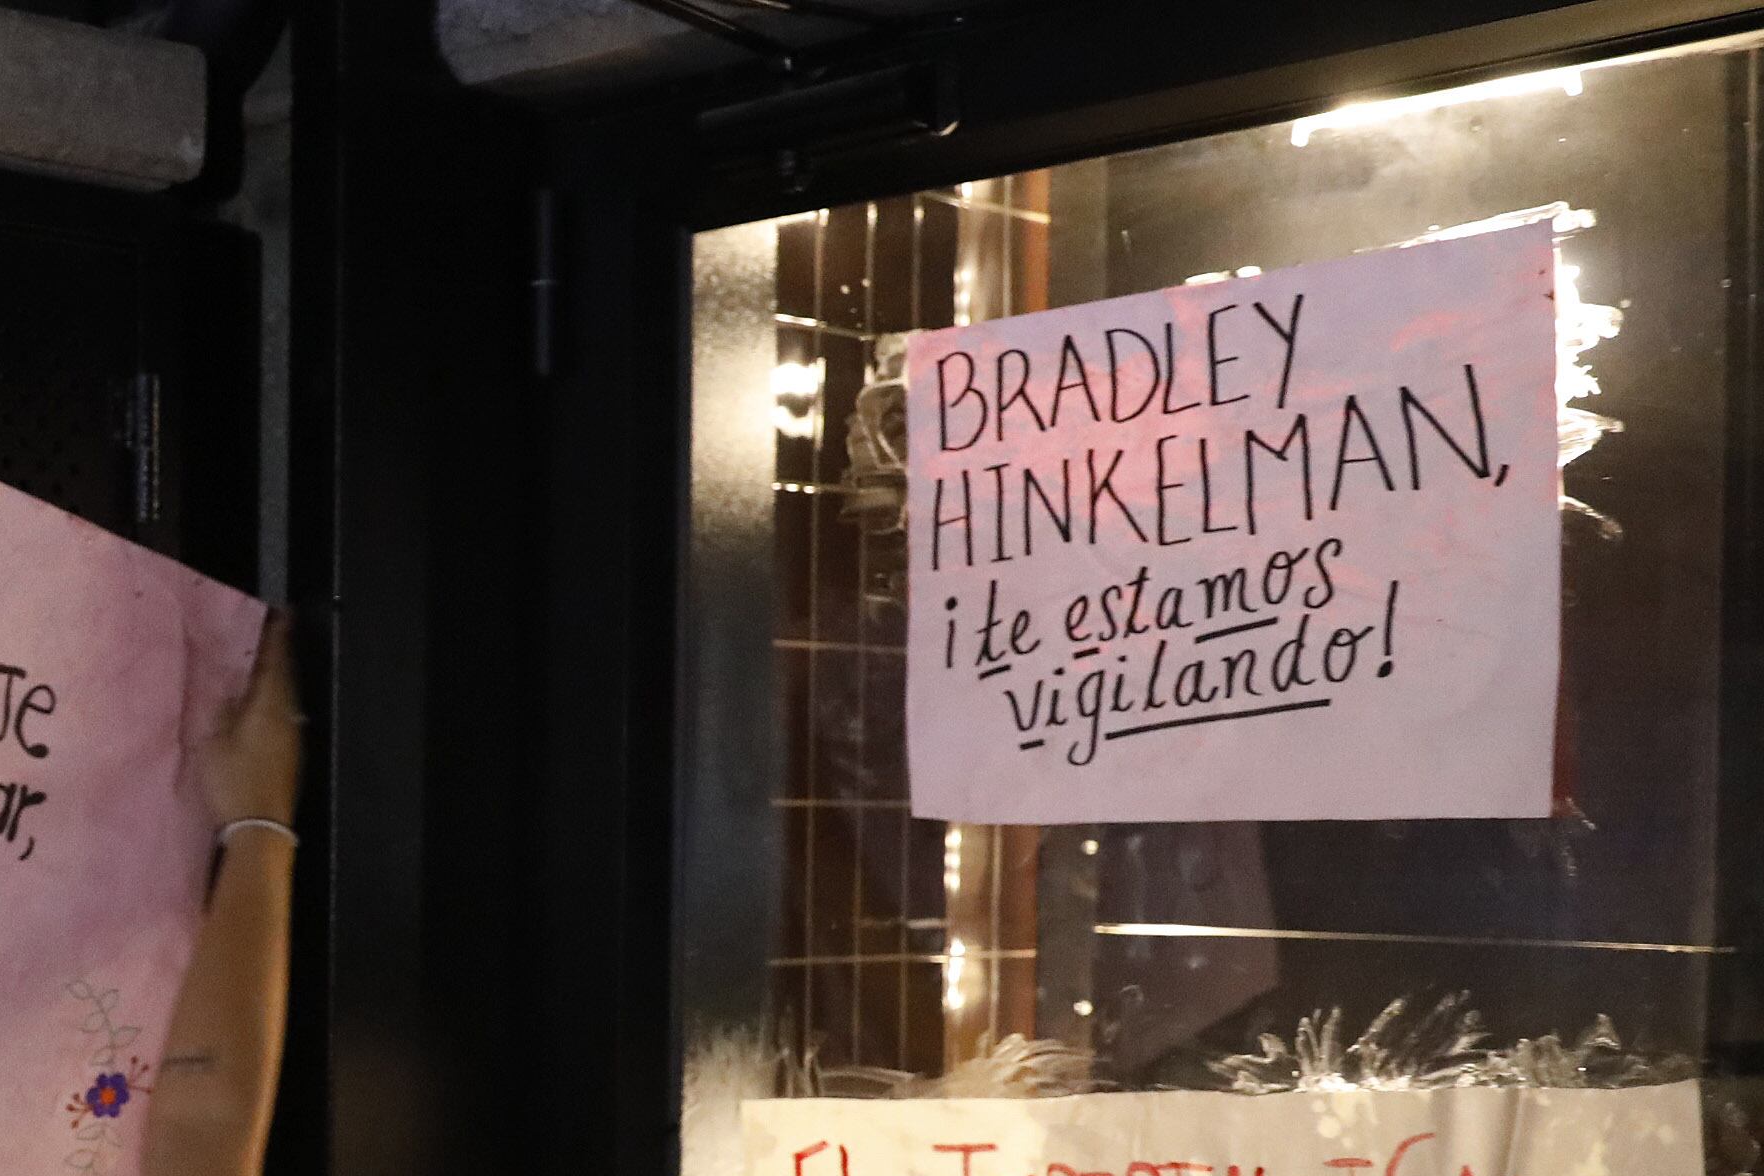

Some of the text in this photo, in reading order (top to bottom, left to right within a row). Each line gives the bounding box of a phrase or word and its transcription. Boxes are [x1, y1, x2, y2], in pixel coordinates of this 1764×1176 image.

[935, 293, 1304, 453] BRADLEY
[932, 364, 1509, 571] HINKELMAN,
[1002, 580, 1400, 768] vigilando!
[1063, 537, 1344, 645] estamos
